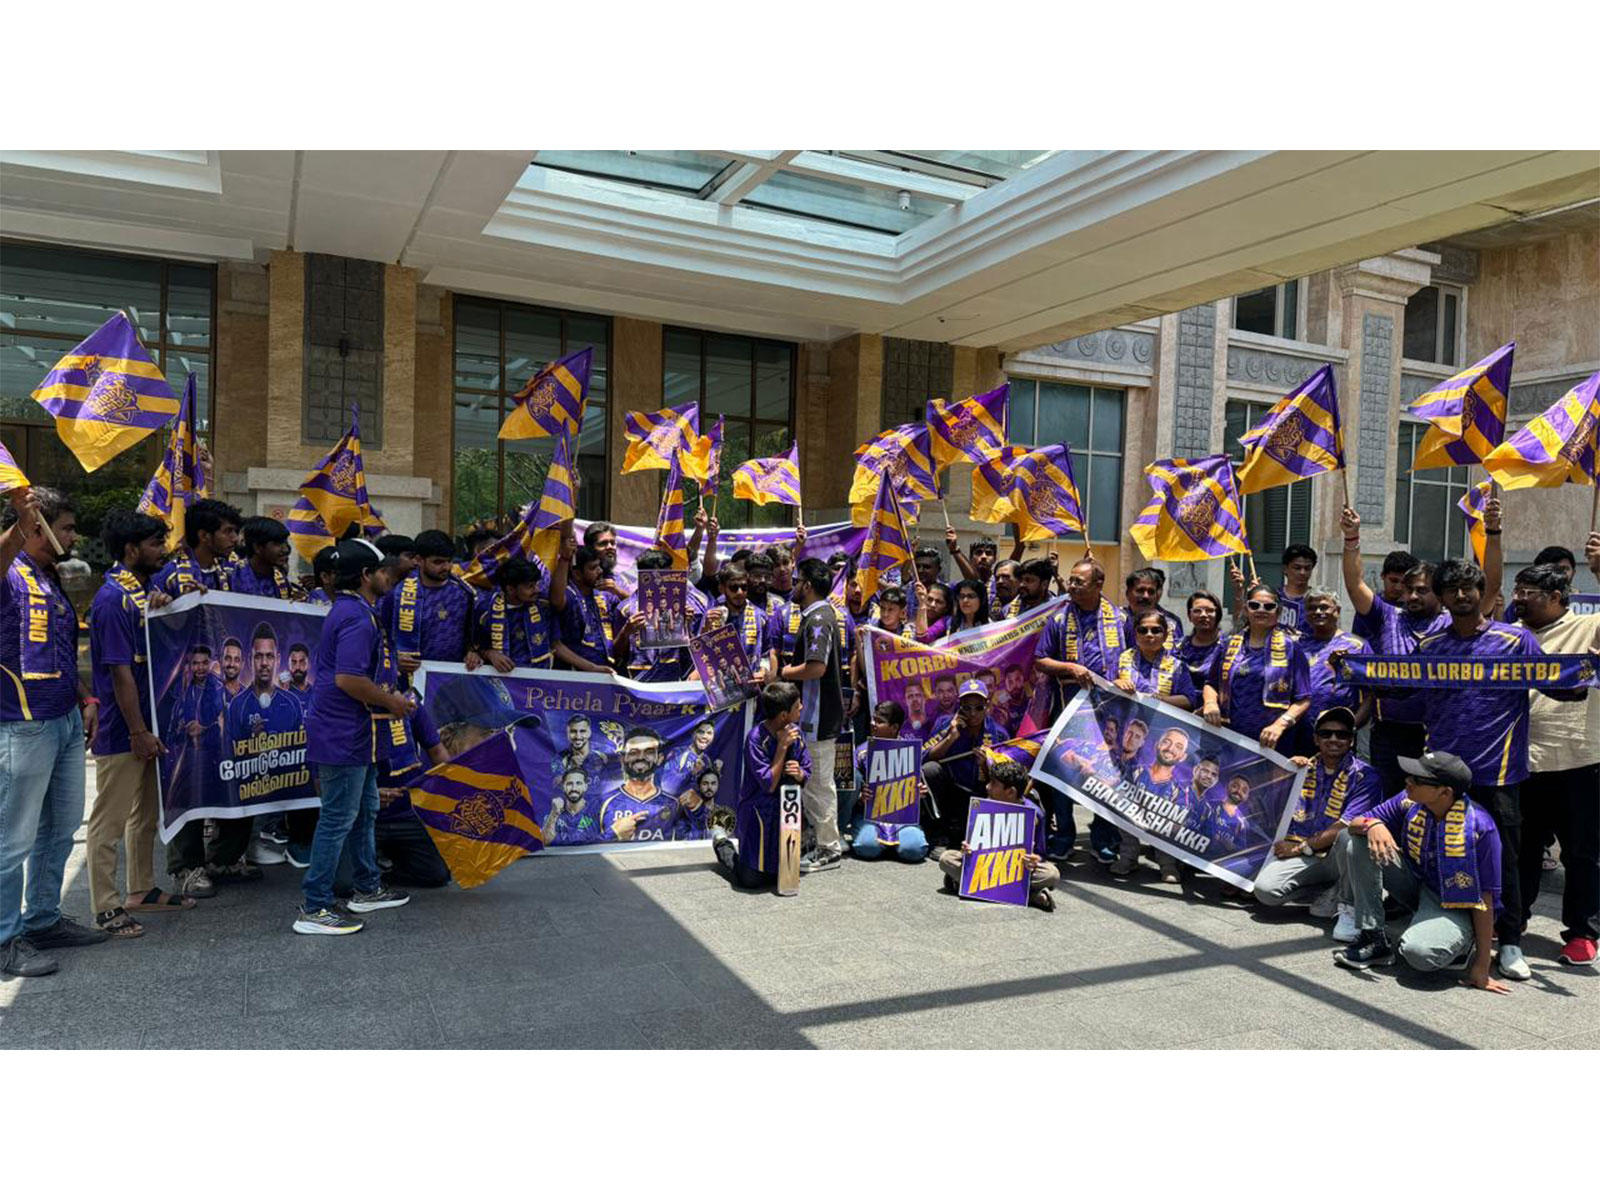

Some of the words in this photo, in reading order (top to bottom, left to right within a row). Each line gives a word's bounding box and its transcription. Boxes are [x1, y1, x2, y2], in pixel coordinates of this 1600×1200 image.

[401, 577, 418, 606] TEAM
[28, 607, 48, 642] ONE
[399, 607, 415, 632] ONE
[1366, 661, 1421, 680] KORBO
[1427, 662, 1484, 681] LORBO
[1490, 662, 1561, 681] JEETBO
[525, 687, 602, 712] Pehela
[389, 718, 408, 746] ONE
[869, 746, 914, 783] AMI
[783, 789, 799, 824] DSC
[871, 776, 917, 819] KKR
[1081, 776, 1174, 838] BHALOBASHA
[1174, 826, 1211, 853] KKR
[1116, 780, 1189, 825] PROTHOM
[970, 813, 1025, 851] AMI
[1444, 800, 1466, 858] KORBO
[967, 848, 1026, 894] KKR
